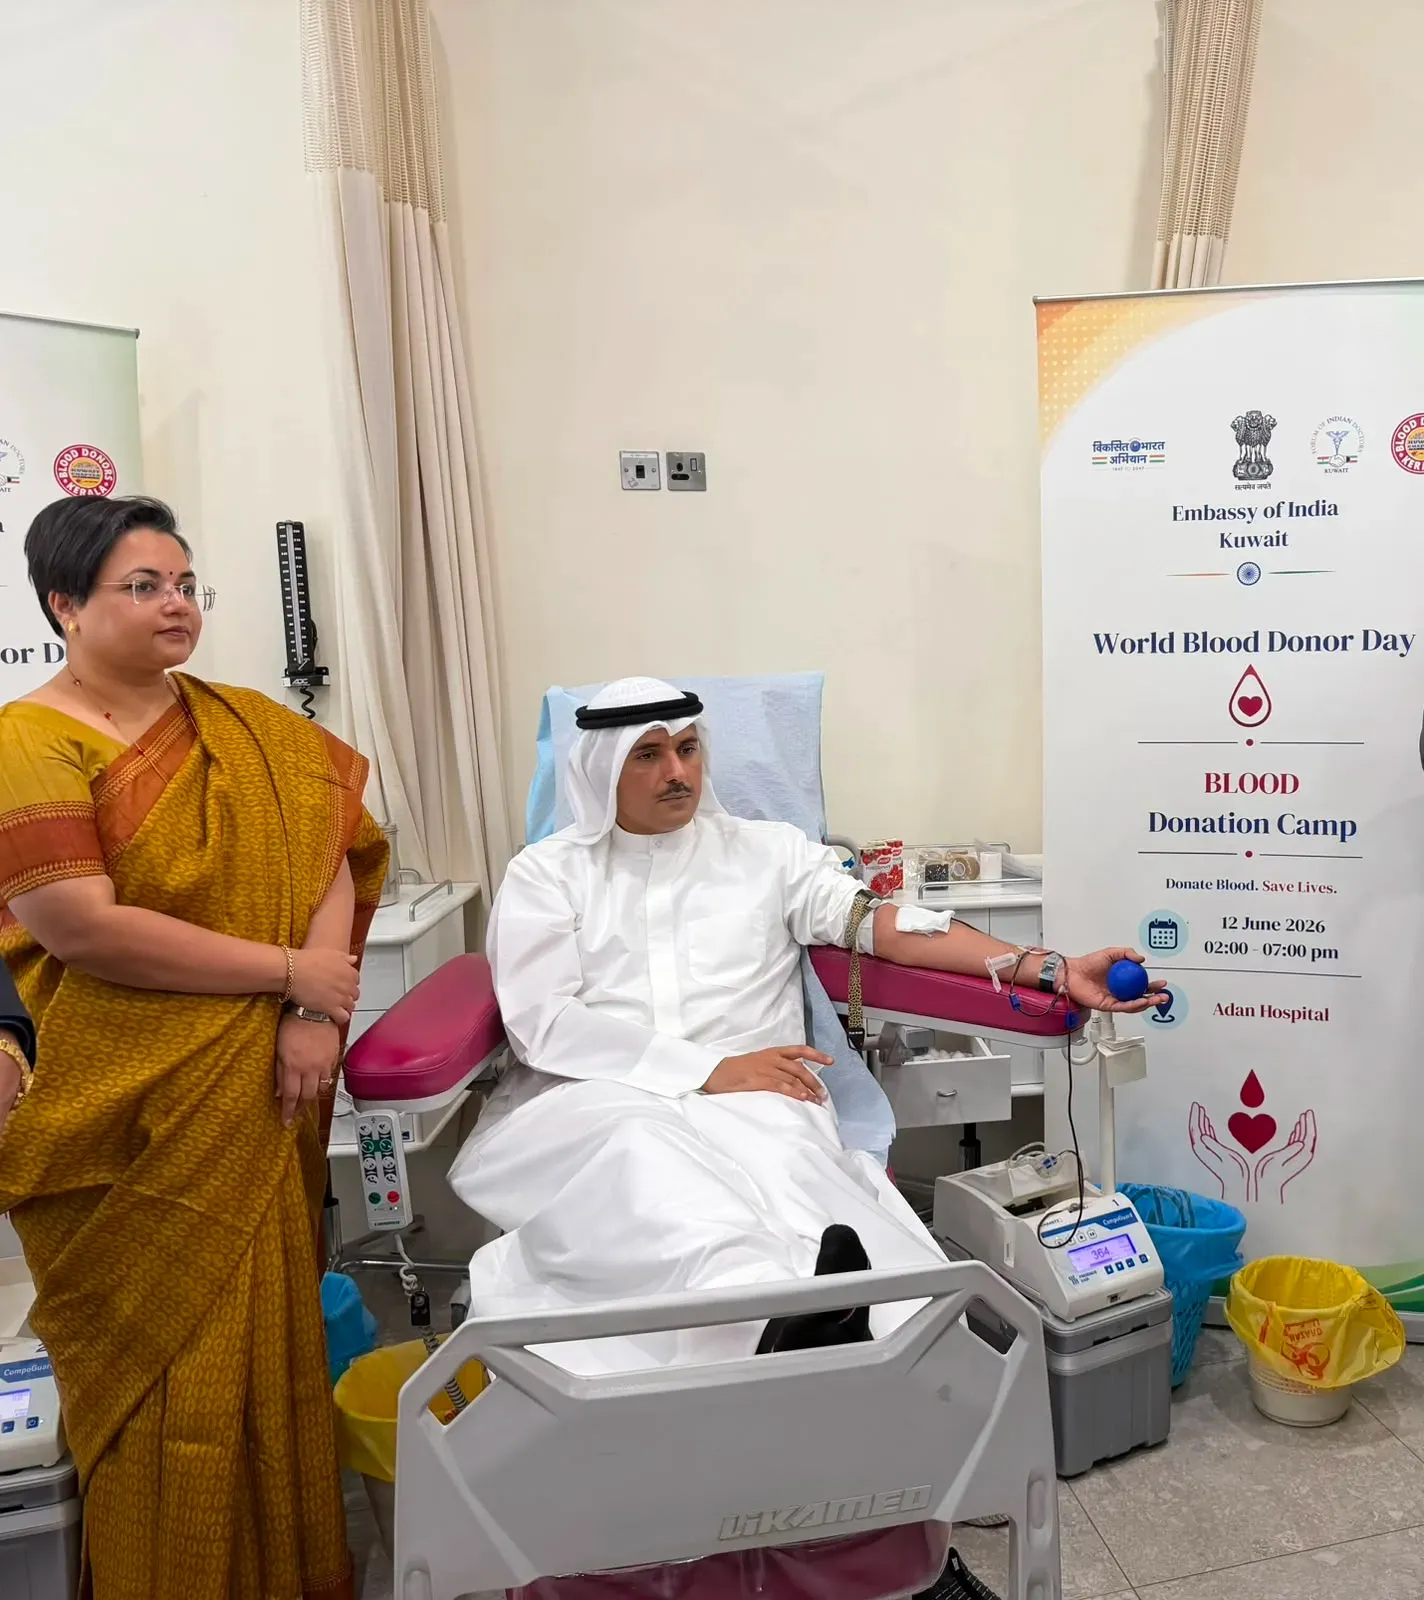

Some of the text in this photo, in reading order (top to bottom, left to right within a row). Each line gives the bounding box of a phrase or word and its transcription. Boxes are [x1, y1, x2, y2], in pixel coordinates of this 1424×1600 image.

[1326, 415, 1353, 424] INDIAN
[1395, 419, 1417, 452] BLOOD
[1092, 440, 1165, 452] विकसित भारत
[58, 449, 79, 478] BLOOD
[81, 448, 113, 481] DONORS
[1109, 452, 1147, 464] अभियान
[1401, 456, 1424, 471] KER
[66, 481, 107, 496] KERALA
[1172, 499, 1339, 524] Embassy of India
[1219, 530, 1289, 549] Kuwait
[1093, 629, 1417, 658] World Blood Donor Day
[1204, 772, 1300, 795] BLOOD
[1148, 811, 1357, 843] Donation Camp
[1165, 878, 1338, 895] Donate Blood. Save Lives.
[1221, 916, 1326, 934] 12 June 2026
[1204, 940, 1249, 955] 02:00
[1262, 943, 1307, 959] 07:00
[1311, 947, 1339, 963] pm
[1213, 1002, 1330, 1024] Adan Hospital
[1091, 1246, 1111, 1261] 364
